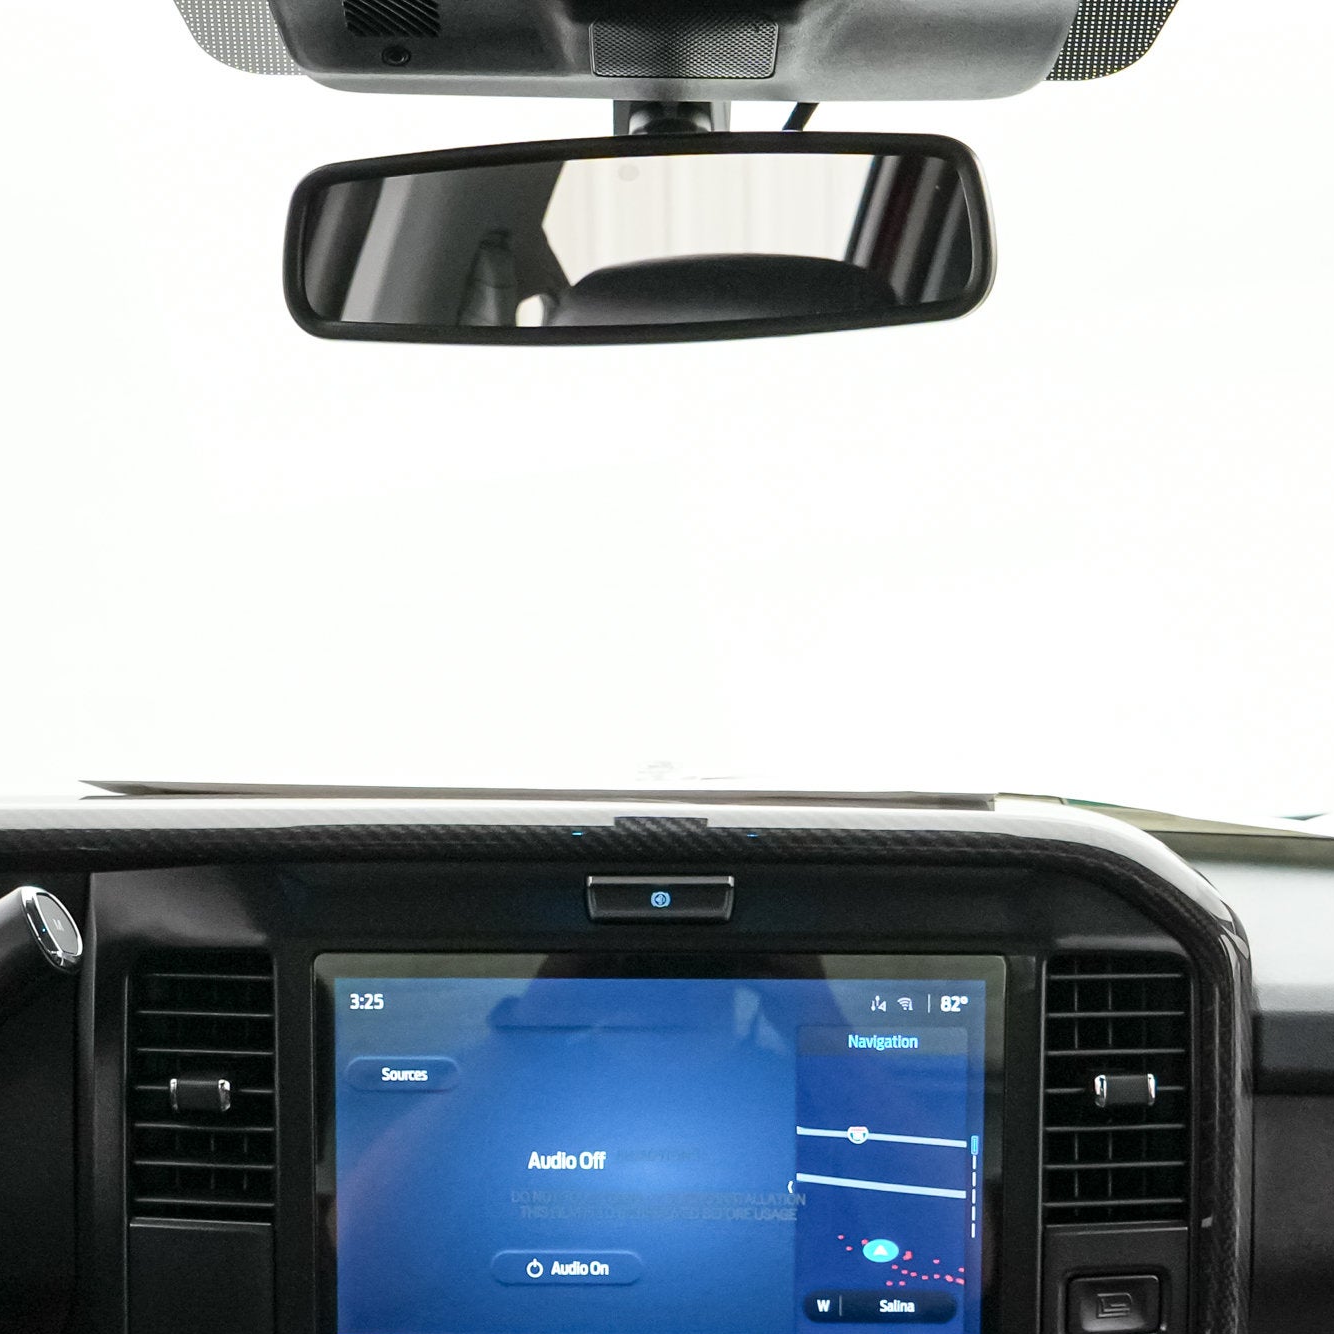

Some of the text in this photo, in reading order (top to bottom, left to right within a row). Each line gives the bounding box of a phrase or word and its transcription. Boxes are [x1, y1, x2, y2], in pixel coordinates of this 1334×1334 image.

[349, 993, 385, 1012] 3:25
[940, 994, 969, 1013] 82°
[847, 1033, 919, 1052] Navigation
[381, 1067, 429, 1082] Sources
[527, 1150, 577, 1170] Audio
[578, 1150, 607, 1170] Off
[550, 1260, 610, 1277] Audio On
[816, 1298, 916, 1314] W Salina
